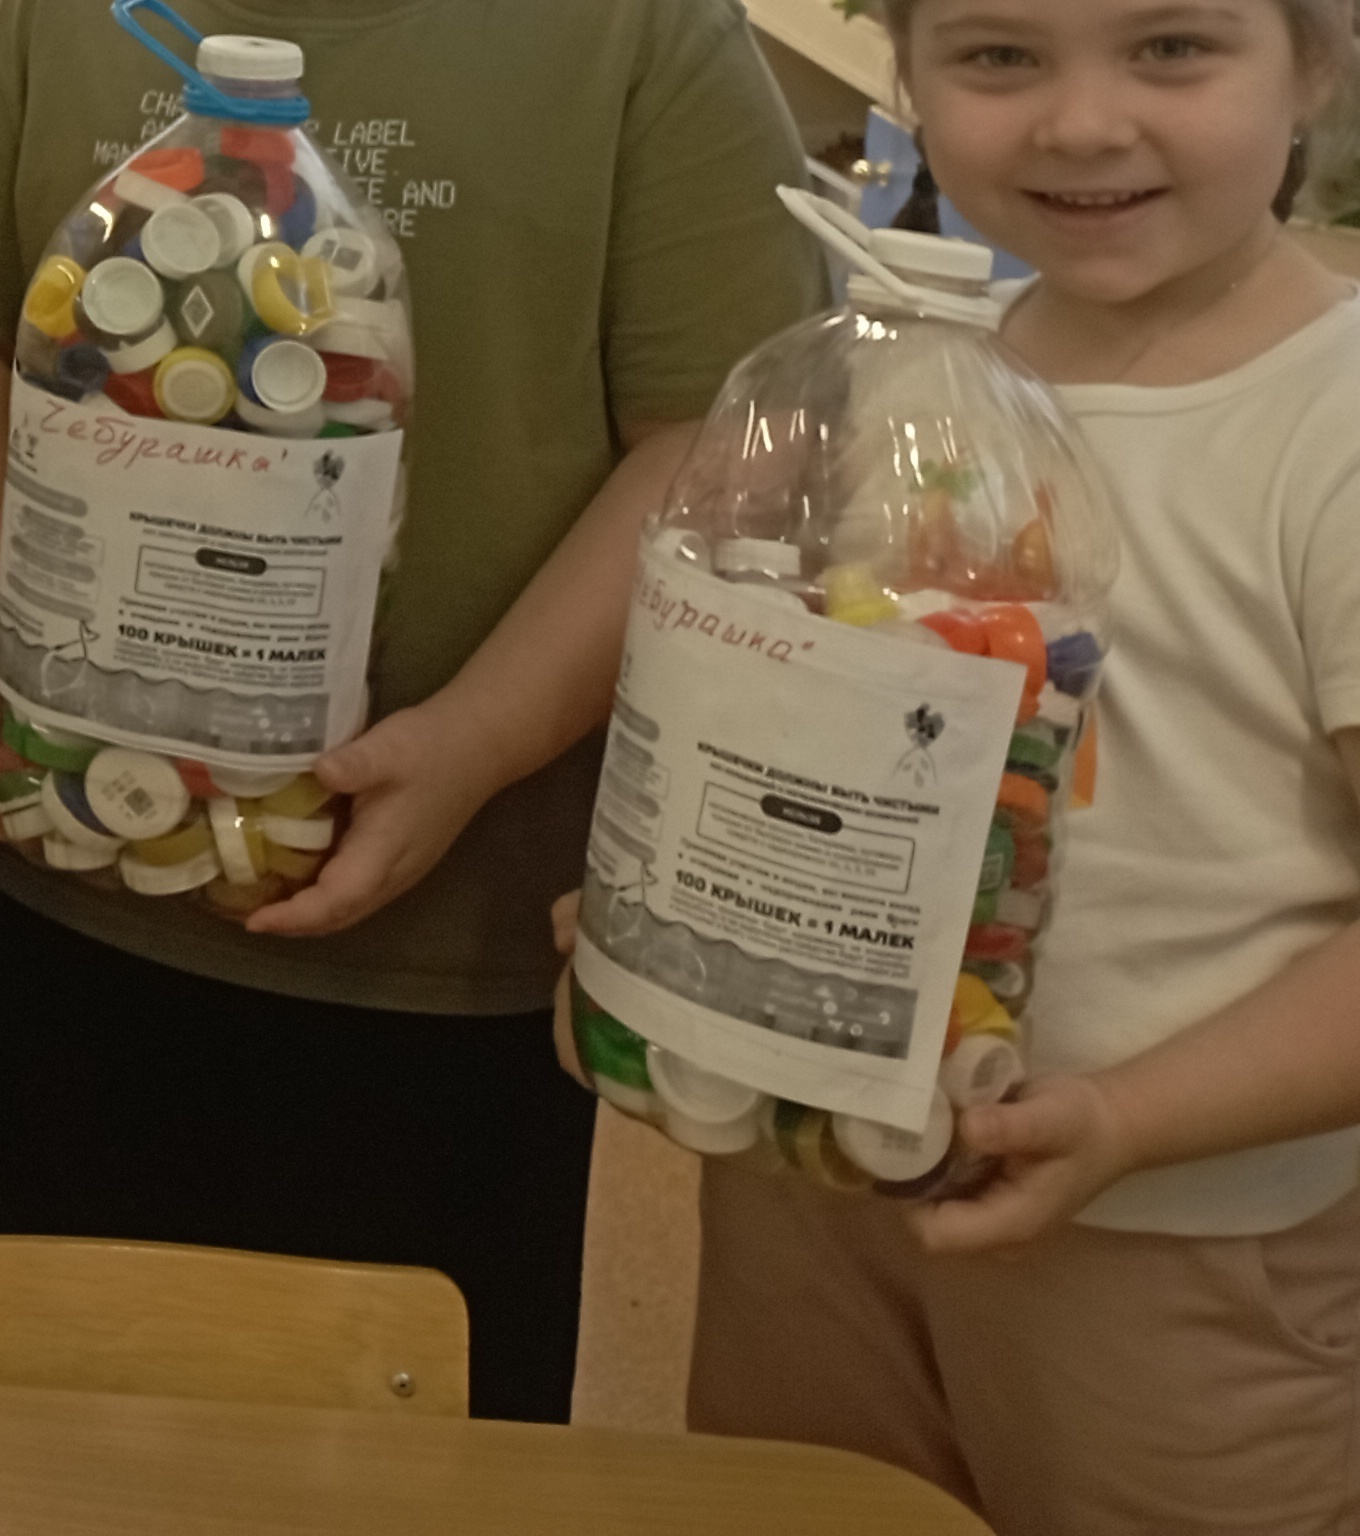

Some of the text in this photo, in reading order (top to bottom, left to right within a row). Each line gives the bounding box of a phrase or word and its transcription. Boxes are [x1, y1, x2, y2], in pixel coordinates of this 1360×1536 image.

[333, 119, 415, 147] LABEL
[326, 147, 398, 176] IVE.
[402, 179, 455, 209] AND
[118, 623, 149, 641] 100
[154, 630, 238, 658] КРЫШЕК
[268, 648, 327, 662] МАЛЕК
[675, 870, 707, 893] 100
[710, 882, 802, 927] КРЫШЕК
[838, 923, 915, 950] МАЛЕК
